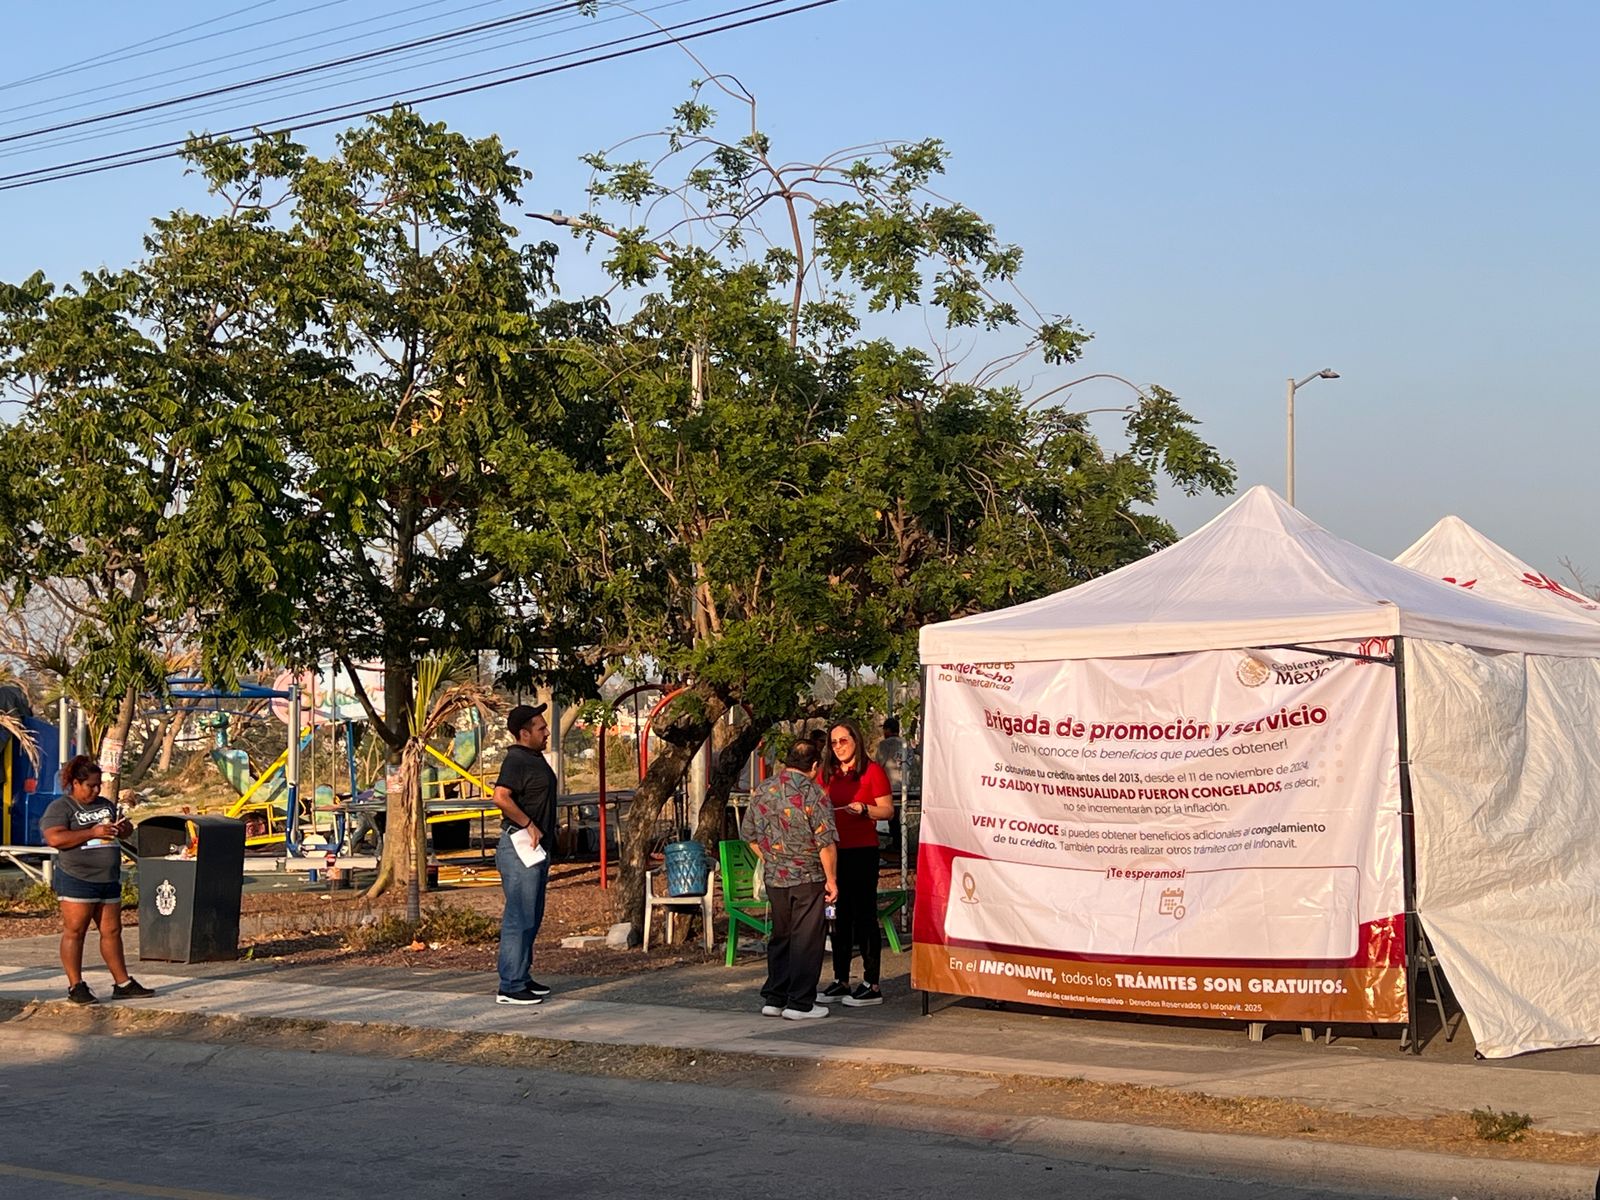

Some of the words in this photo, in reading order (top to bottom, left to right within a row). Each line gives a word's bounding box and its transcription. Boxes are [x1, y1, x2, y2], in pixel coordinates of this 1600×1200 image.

[1271, 658, 1325, 672] Gobierno
[938, 673, 952, 682] no
[984, 708, 1050, 736] Brigada
[1056, 717, 1085, 738] de
[1089, 719, 1210, 743] promoción
[1215, 724, 1230, 741] y
[1231, 705, 1328, 735] servicio
[1037, 746, 1079, 758] conoce
[1081, 747, 1097, 758] los
[1100, 748, 1158, 759] beneficios
[1160, 750, 1182, 760] que
[1184, 745, 1229, 761] puedes
[1232, 738, 1289, 756] obtener!
[1037, 769, 1045, 778] tu
[1046, 769, 1075, 781] crédito
[1076, 773, 1100, 782] antes
[1102, 772, 1116, 783] del
[1118, 772, 1143, 784] 2013,
[1144, 771, 1175, 783] desde
[1177, 773, 1186, 783] el
[1189, 773, 1197, 782] 11
[1198, 771, 1213, 781] de
[1215, 765, 1274, 780] noviembre
[1276, 764, 1289, 775] de
[980, 775, 997, 787] TU
[999, 778, 1033, 792] SALDO
[1033, 782, 1040, 793] Y
[1041, 783, 1054, 796] TU
[1056, 785, 1136, 800] MENSUALIDAD
[1138, 788, 1189, 800] FUERON
[1191, 780, 1282, 799] CONGELADOS,
[1284, 782, 1293, 790] es
[1063, 803, 1074, 812] no
[1076, 804, 1086, 812] se
[1088, 803, 1152, 814] incrementarán
[1154, 804, 1171, 815] por
[1173, 803, 1182, 813] la
[1184, 802, 1230, 813] inflación.
[972, 815, 996, 829] VEN
[999, 818, 1007, 829] Y
[1008, 820, 1059, 836] CONOCE
[1060, 827, 1067, 836] si
[1068, 827, 1099, 839] puedes
[1101, 830, 1137, 840] obtener
[1139, 830, 1191, 841] beneficios
[1192, 828, 1242, 840] adicionales
[1251, 822, 1326, 836] congelamiento
[993, 833, 1006, 844] de
[1008, 835, 1018, 845] tu
[1020, 836, 1057, 850] crédito.
[1059, 841, 1095, 853] También
[1097, 843, 1128, 855] podrás
[1130, 844, 1164, 855] realizar
[1166, 845, 1191, 855] otros
[1193, 843, 1226, 855] trámites
[1227, 843, 1242, 852] con
[1244, 839, 1252, 850] el
[1106, 867, 1122, 880] ¡Te
[1125, 868, 1186, 881] esperamos!
[949, 956, 963, 970] En
[965, 959, 977, 973] el
[979, 959, 1057, 984] INFONAVIT,
[1061, 971, 1093, 986] todos
[1096, 973, 1112, 987] los
[1115, 970, 1198, 991] TRÁMITES
[1203, 977, 1242, 993] SON
[1248, 978, 1348, 994] GRATUITOS.
[1027, 989, 1052, 999] Material
[1052, 992, 1060, 1000] de
[1129, 998, 1160, 1008] Derechos
[1161, 1000, 1201, 1010] Reservados
[1244, 1003, 1263, 1012] 2025
